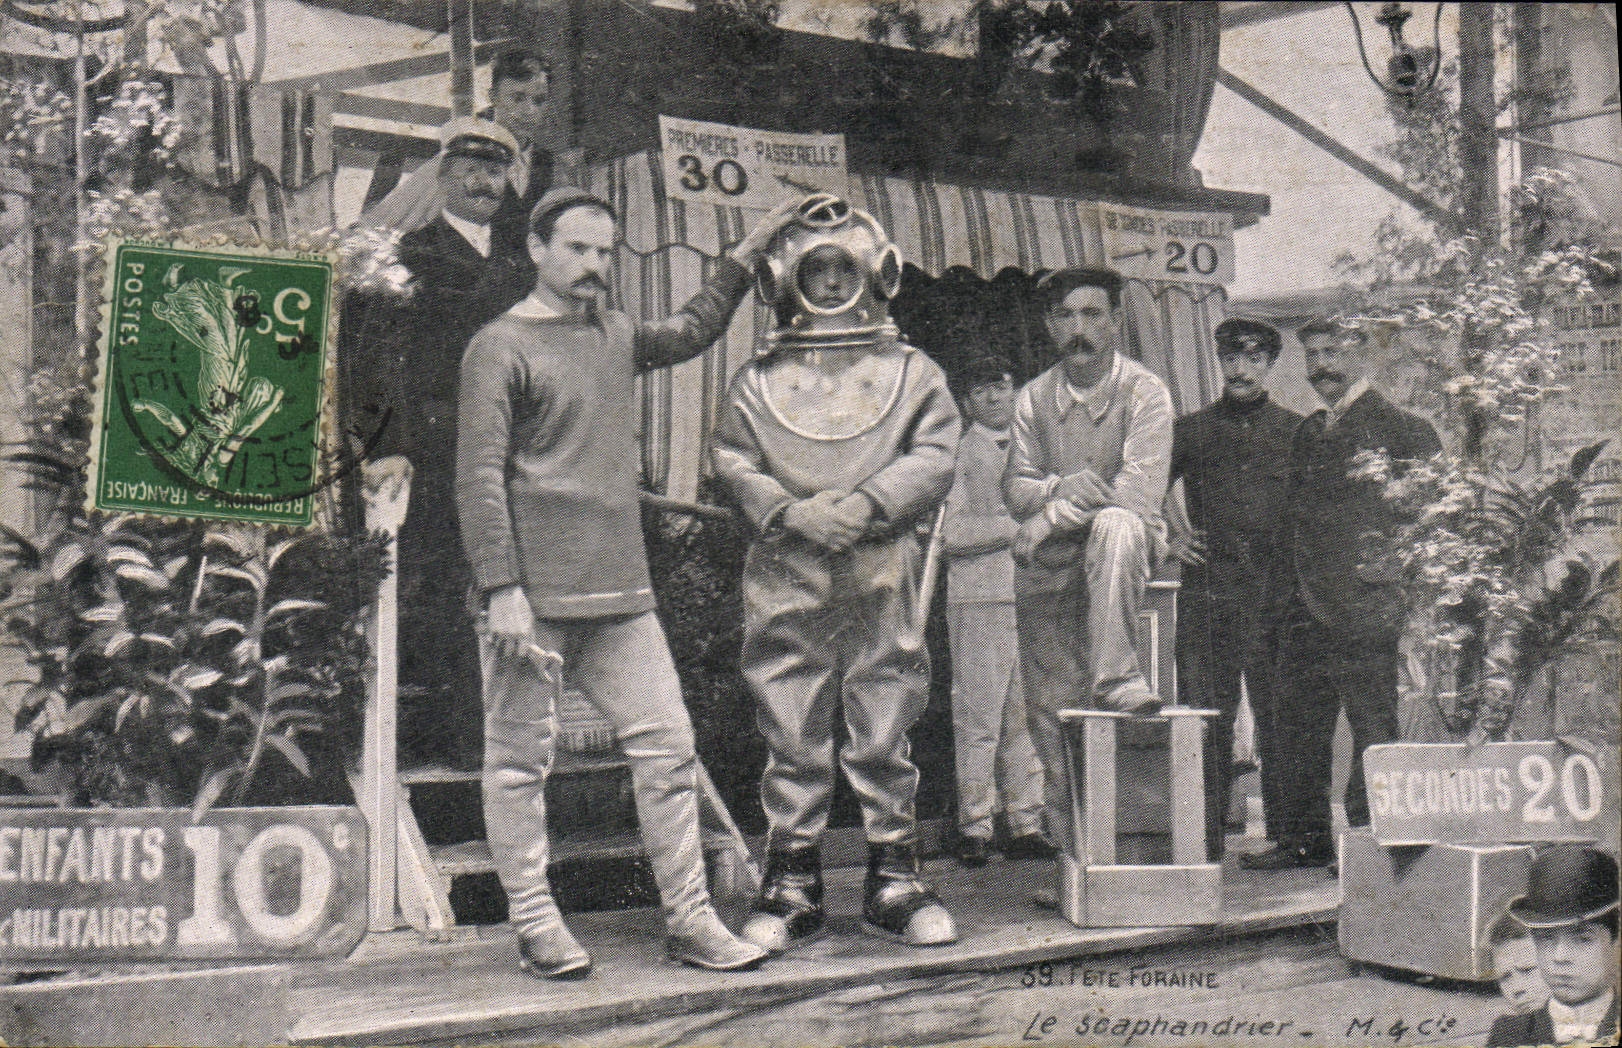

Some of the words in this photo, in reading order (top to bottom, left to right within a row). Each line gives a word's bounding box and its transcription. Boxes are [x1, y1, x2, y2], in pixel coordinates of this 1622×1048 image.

[678, 154, 749, 196] 30
[1166, 241, 1219, 275] 20
[120, 262, 144, 346] POSTES
[106, 480, 187, 505] FRANÇAISE
[1373, 768, 1512, 815] SECONDES
[1518, 755, 1602, 822] 20
[0, 826, 165, 881] ENFANTS
[13, 905, 168, 947] MILITAIRES
